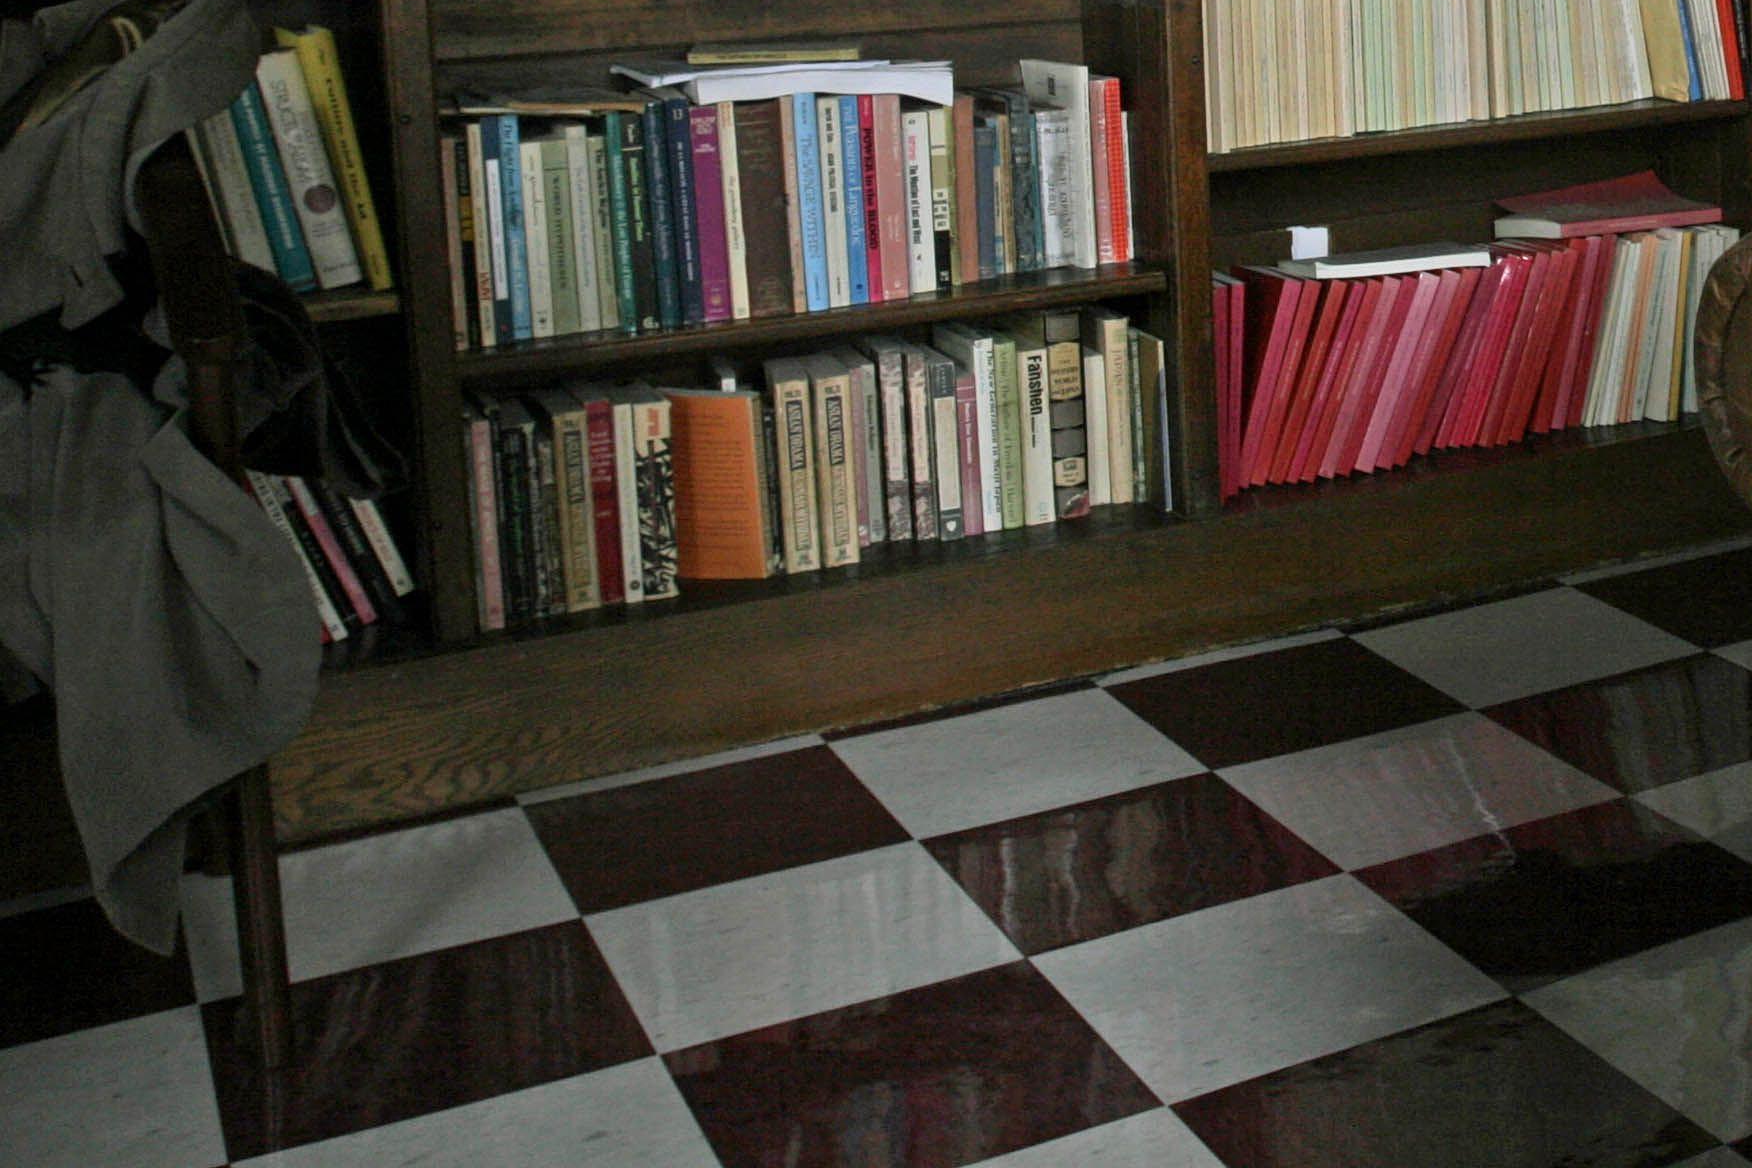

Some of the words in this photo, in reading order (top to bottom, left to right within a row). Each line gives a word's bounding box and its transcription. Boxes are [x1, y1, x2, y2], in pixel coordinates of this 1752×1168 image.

[862, 128, 874, 171] POWER
[551, 176, 563, 215] WORLD
[866, 188, 875, 206] the
[866, 209, 878, 250] BLOOD
[1026, 355, 1044, 415] Fanshen
[786, 403, 802, 432] ASIAN
[826, 399, 842, 429] ASIAN
[788, 433, 804, 468] DRAMA
[828, 429, 844, 464] DRAMA
